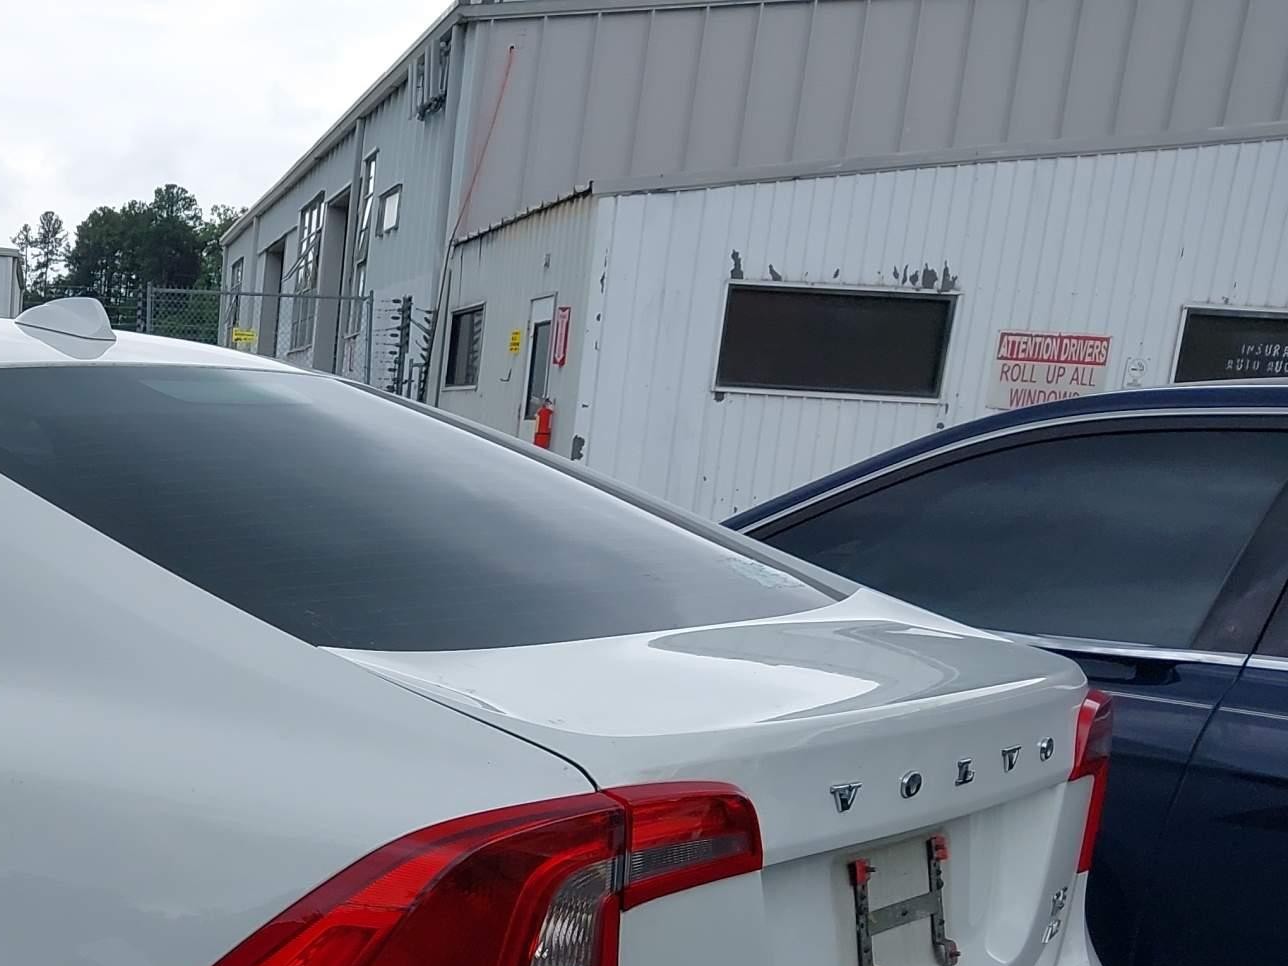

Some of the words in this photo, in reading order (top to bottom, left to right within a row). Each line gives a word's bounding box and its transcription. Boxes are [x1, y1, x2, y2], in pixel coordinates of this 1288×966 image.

[998, 335, 1060, 360] ATTENTION
[1060, 338, 1108, 363] DRIVERS
[1000, 363, 1037, 383] ROLL
[1046, 365, 1066, 385] UP
[1070, 367, 1096, 387] ALL
[829, 736, 1055, 814] VOLVO
